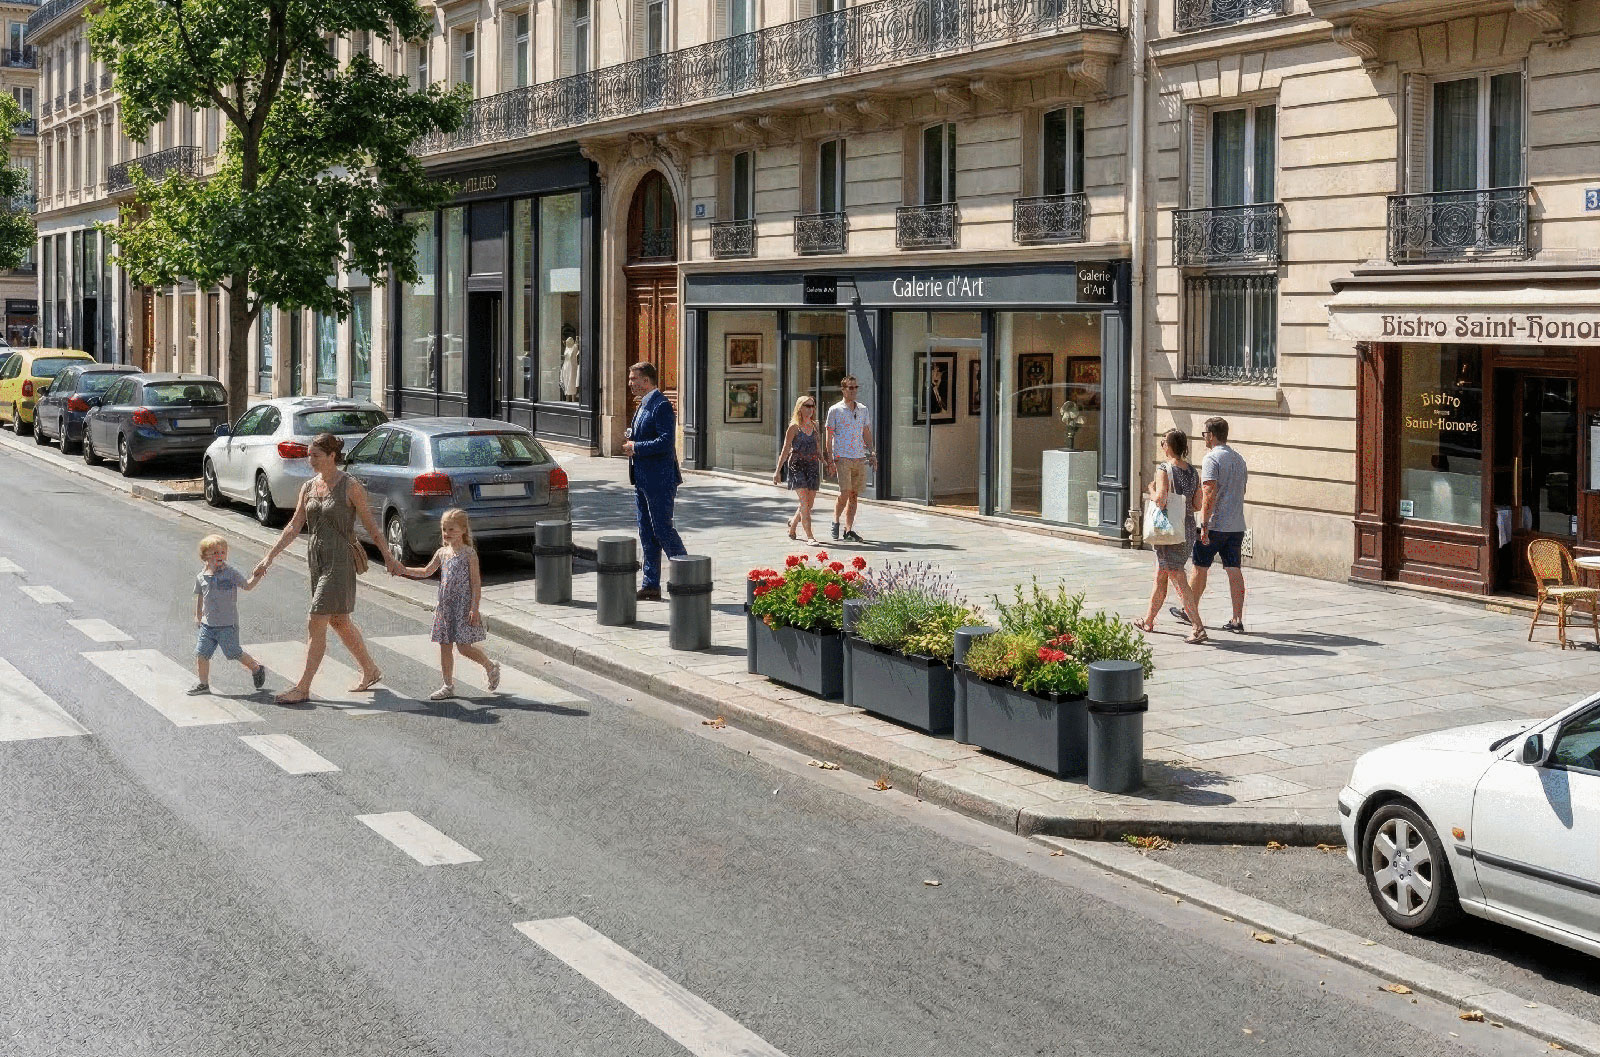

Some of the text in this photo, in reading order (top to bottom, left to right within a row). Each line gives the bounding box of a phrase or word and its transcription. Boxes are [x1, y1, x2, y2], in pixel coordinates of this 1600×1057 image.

[1587, 190, 1600, 209] 3
[1078, 269, 1111, 282] Galerie
[892, 274, 984, 298] Galerie d'Art
[1083, 282, 1107, 296] d'Art
[1381, 315, 1448, 337] Bistro
[1420, 390, 1461, 408] Bistro
[1405, 416, 1478, 432] Saint-Honoré
